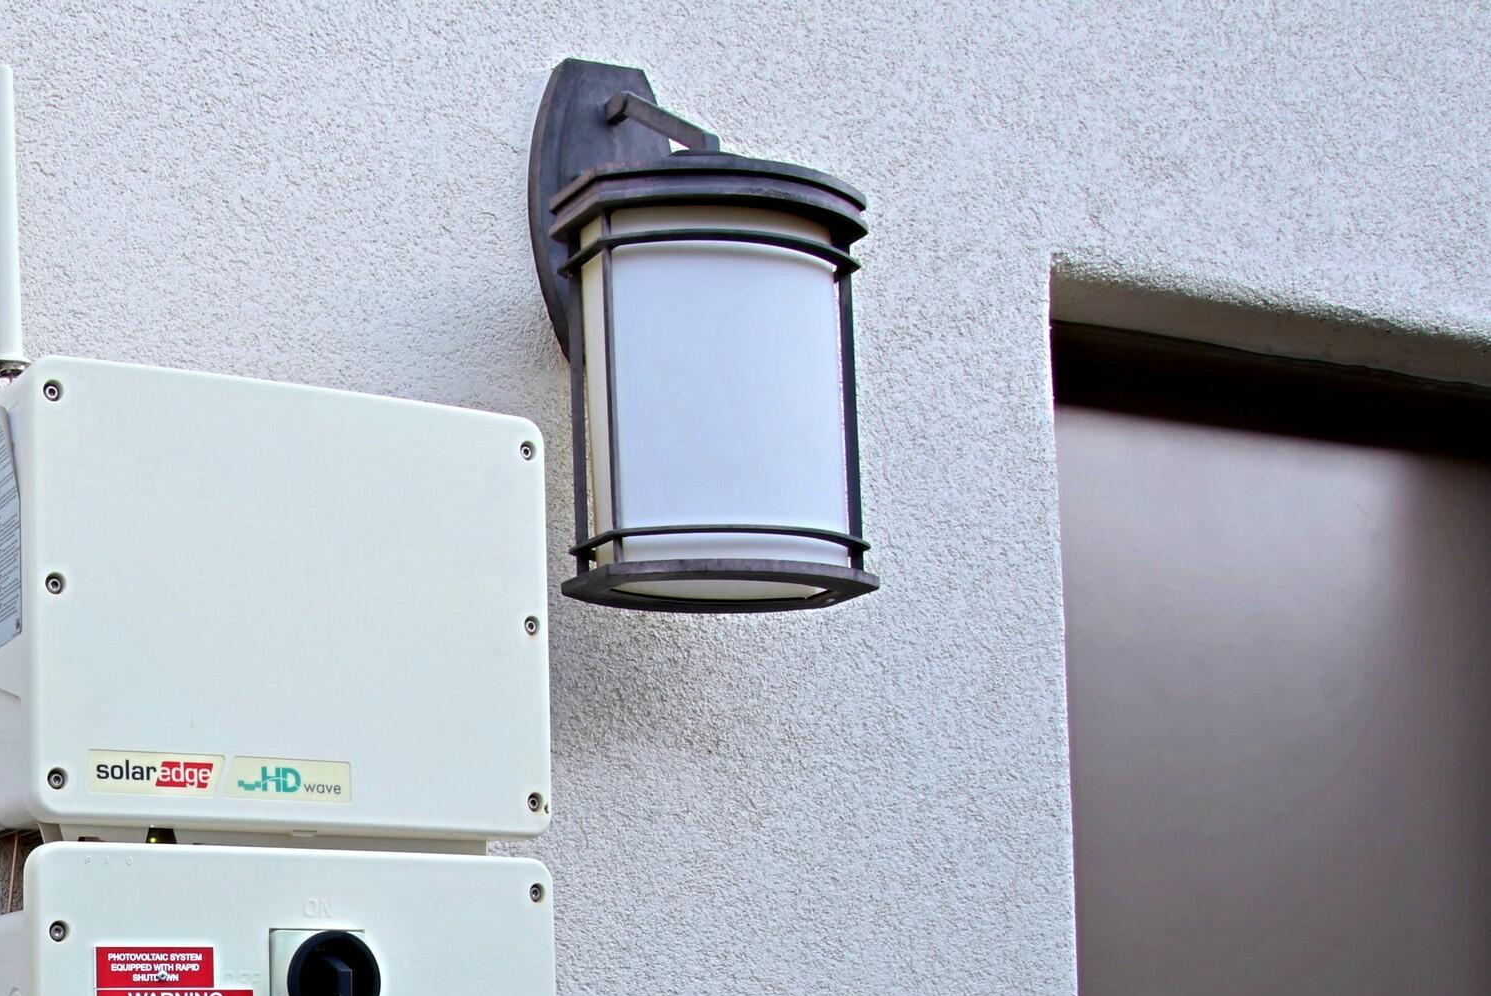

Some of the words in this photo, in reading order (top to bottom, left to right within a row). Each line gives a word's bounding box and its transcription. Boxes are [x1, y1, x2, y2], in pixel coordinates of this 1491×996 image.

[96, 760, 212, 788] solaredge
[261, 766, 302, 794] HD
[304, 783, 342, 795] wave
[302, 899, 333, 918] ON
[108, 953, 168, 961] PHOTOVOLTAIC
[111, 964, 152, 972] EQUIPPED
